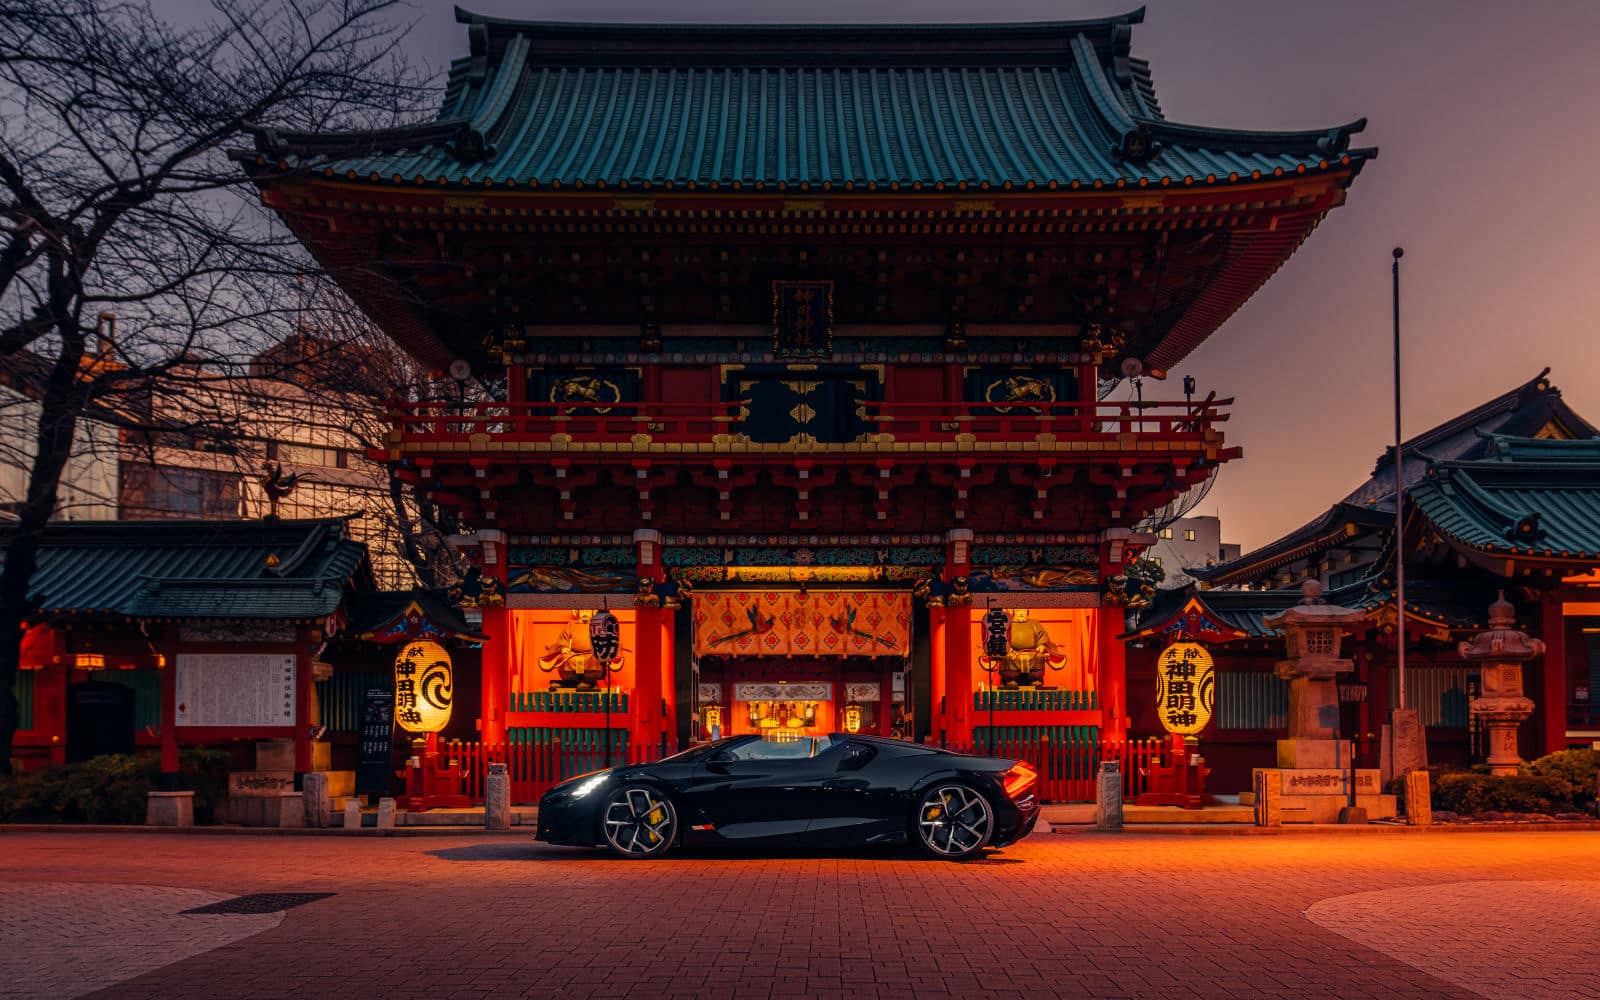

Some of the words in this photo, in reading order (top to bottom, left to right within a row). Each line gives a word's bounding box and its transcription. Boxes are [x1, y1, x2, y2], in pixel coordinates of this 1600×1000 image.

[396, 657, 422, 725] 神田明神
[1165, 659, 1197, 727] 神田明神
